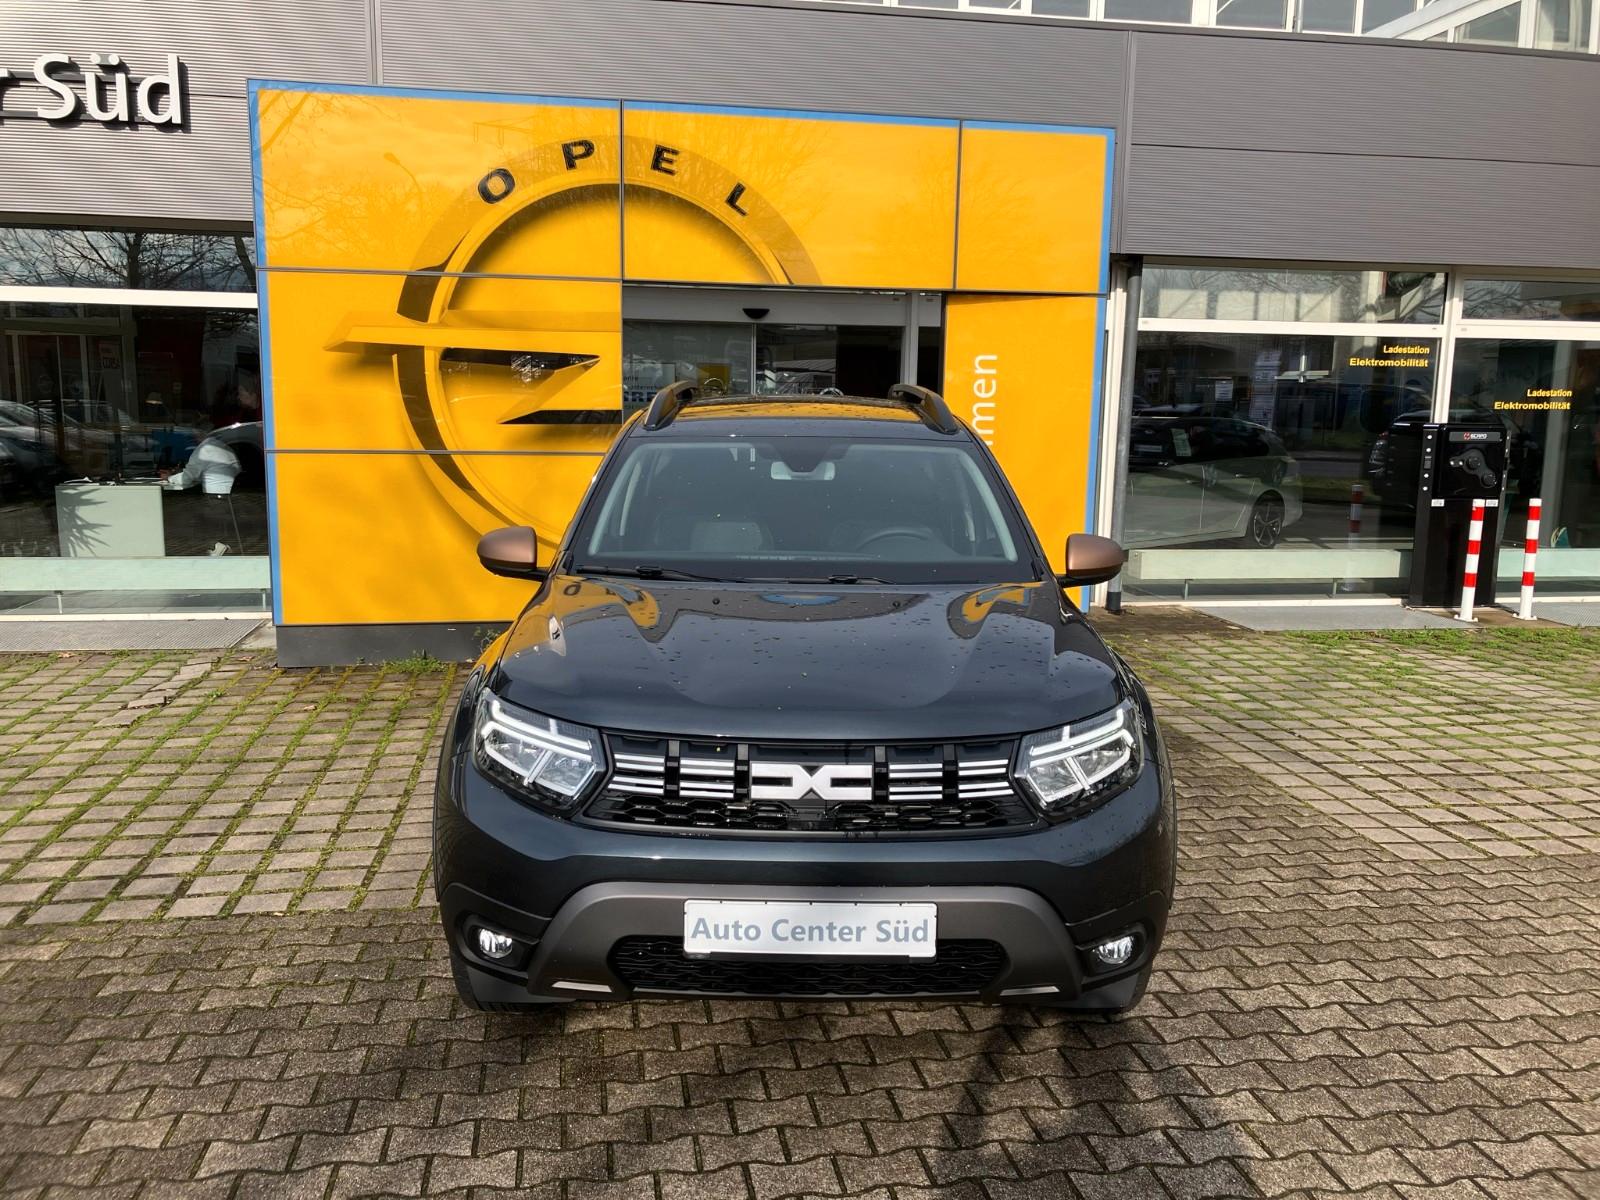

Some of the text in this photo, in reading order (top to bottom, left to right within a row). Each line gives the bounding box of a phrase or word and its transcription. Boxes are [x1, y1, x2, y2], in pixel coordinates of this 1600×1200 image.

[33, 52, 182, 125] Süd
[477, 139, 749, 217] OPEL
[1383, 344, 1430, 354] Ladestation
[1349, 357, 1429, 368] Elektromobilität
[971, 354, 999, 446] men
[1526, 388, 1573, 398] Ladestation
[1494, 401, 1571, 411] Elektromobilität
[690, 917, 929, 944] Auto Center Süd
